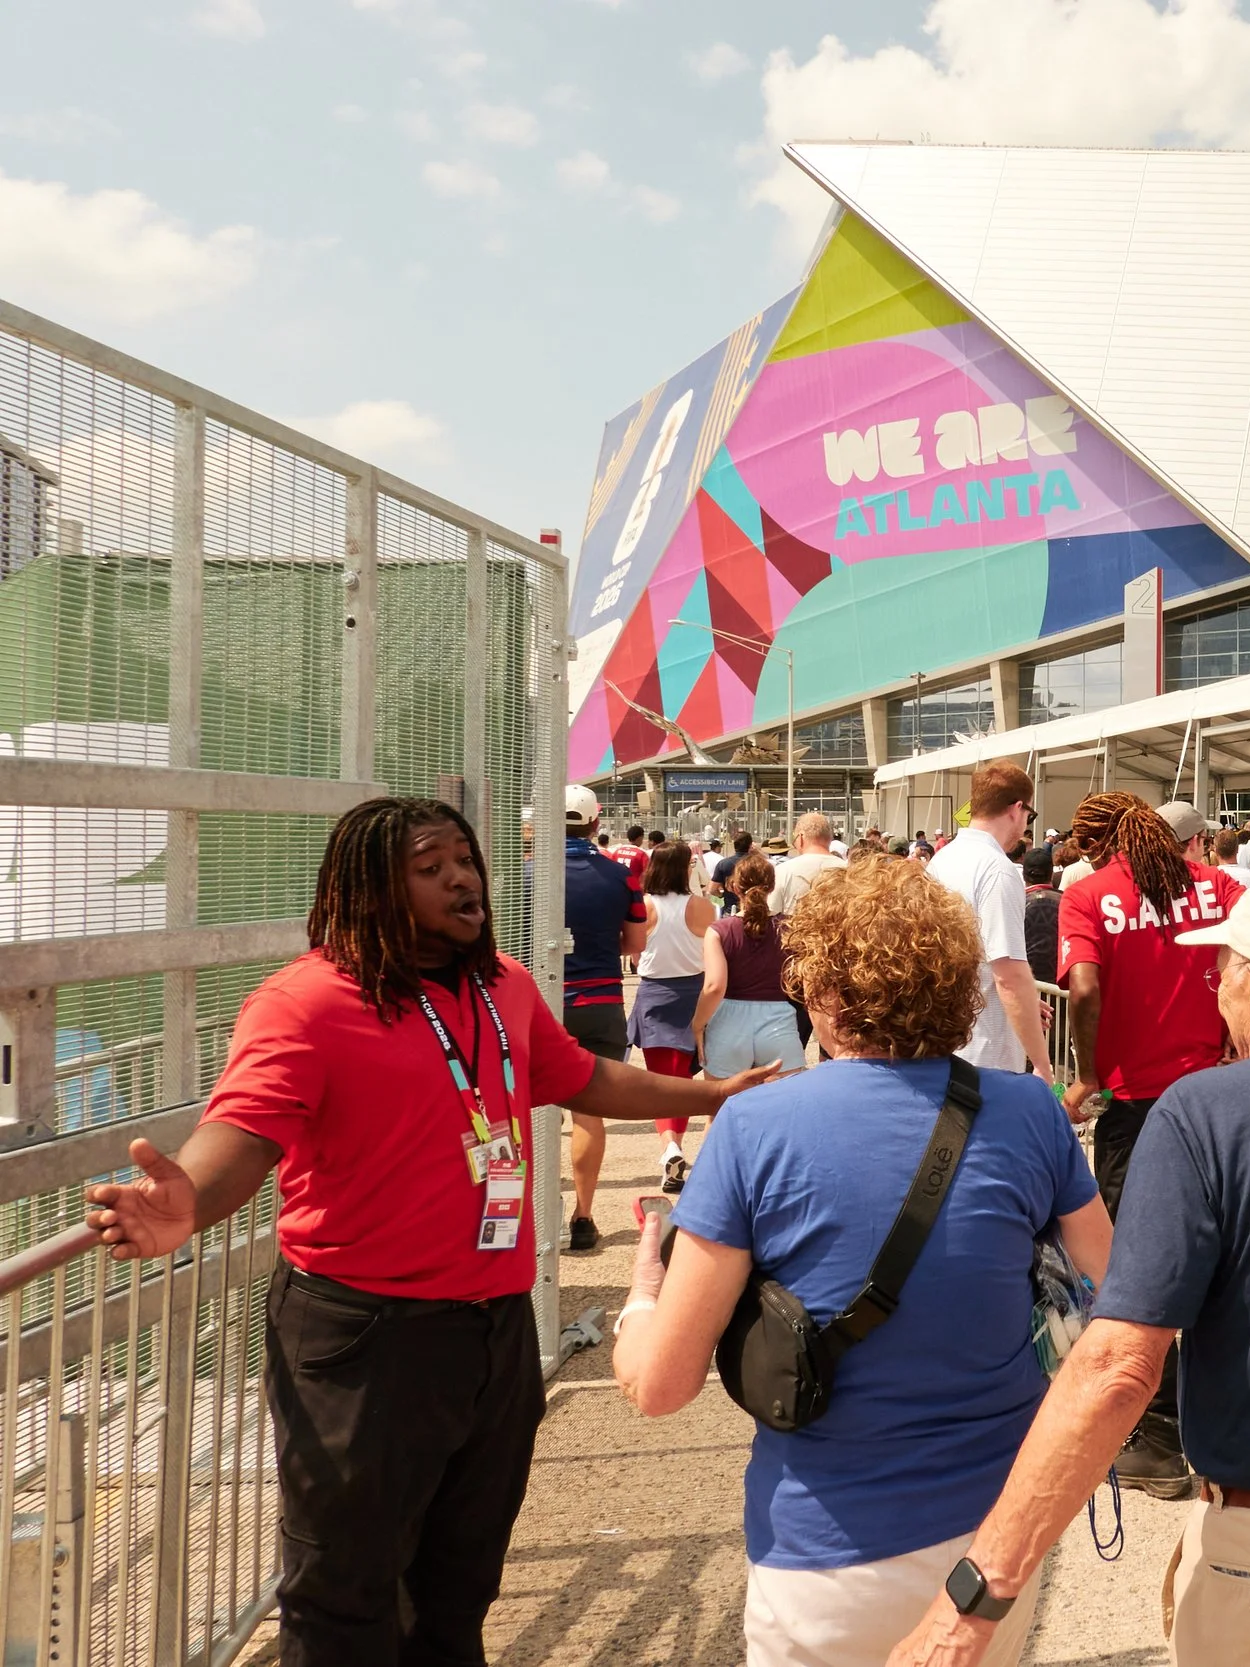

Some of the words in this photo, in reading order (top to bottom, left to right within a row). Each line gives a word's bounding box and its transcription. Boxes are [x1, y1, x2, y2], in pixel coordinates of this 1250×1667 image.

[834, 468, 1081, 540] ATLANTA
[422, 1002, 437, 1020] CUP
[431, 1020, 451, 1051] 2026
[487, 1001, 504, 1031] WORLD
[499, 1031, 509, 1051] FIFA
